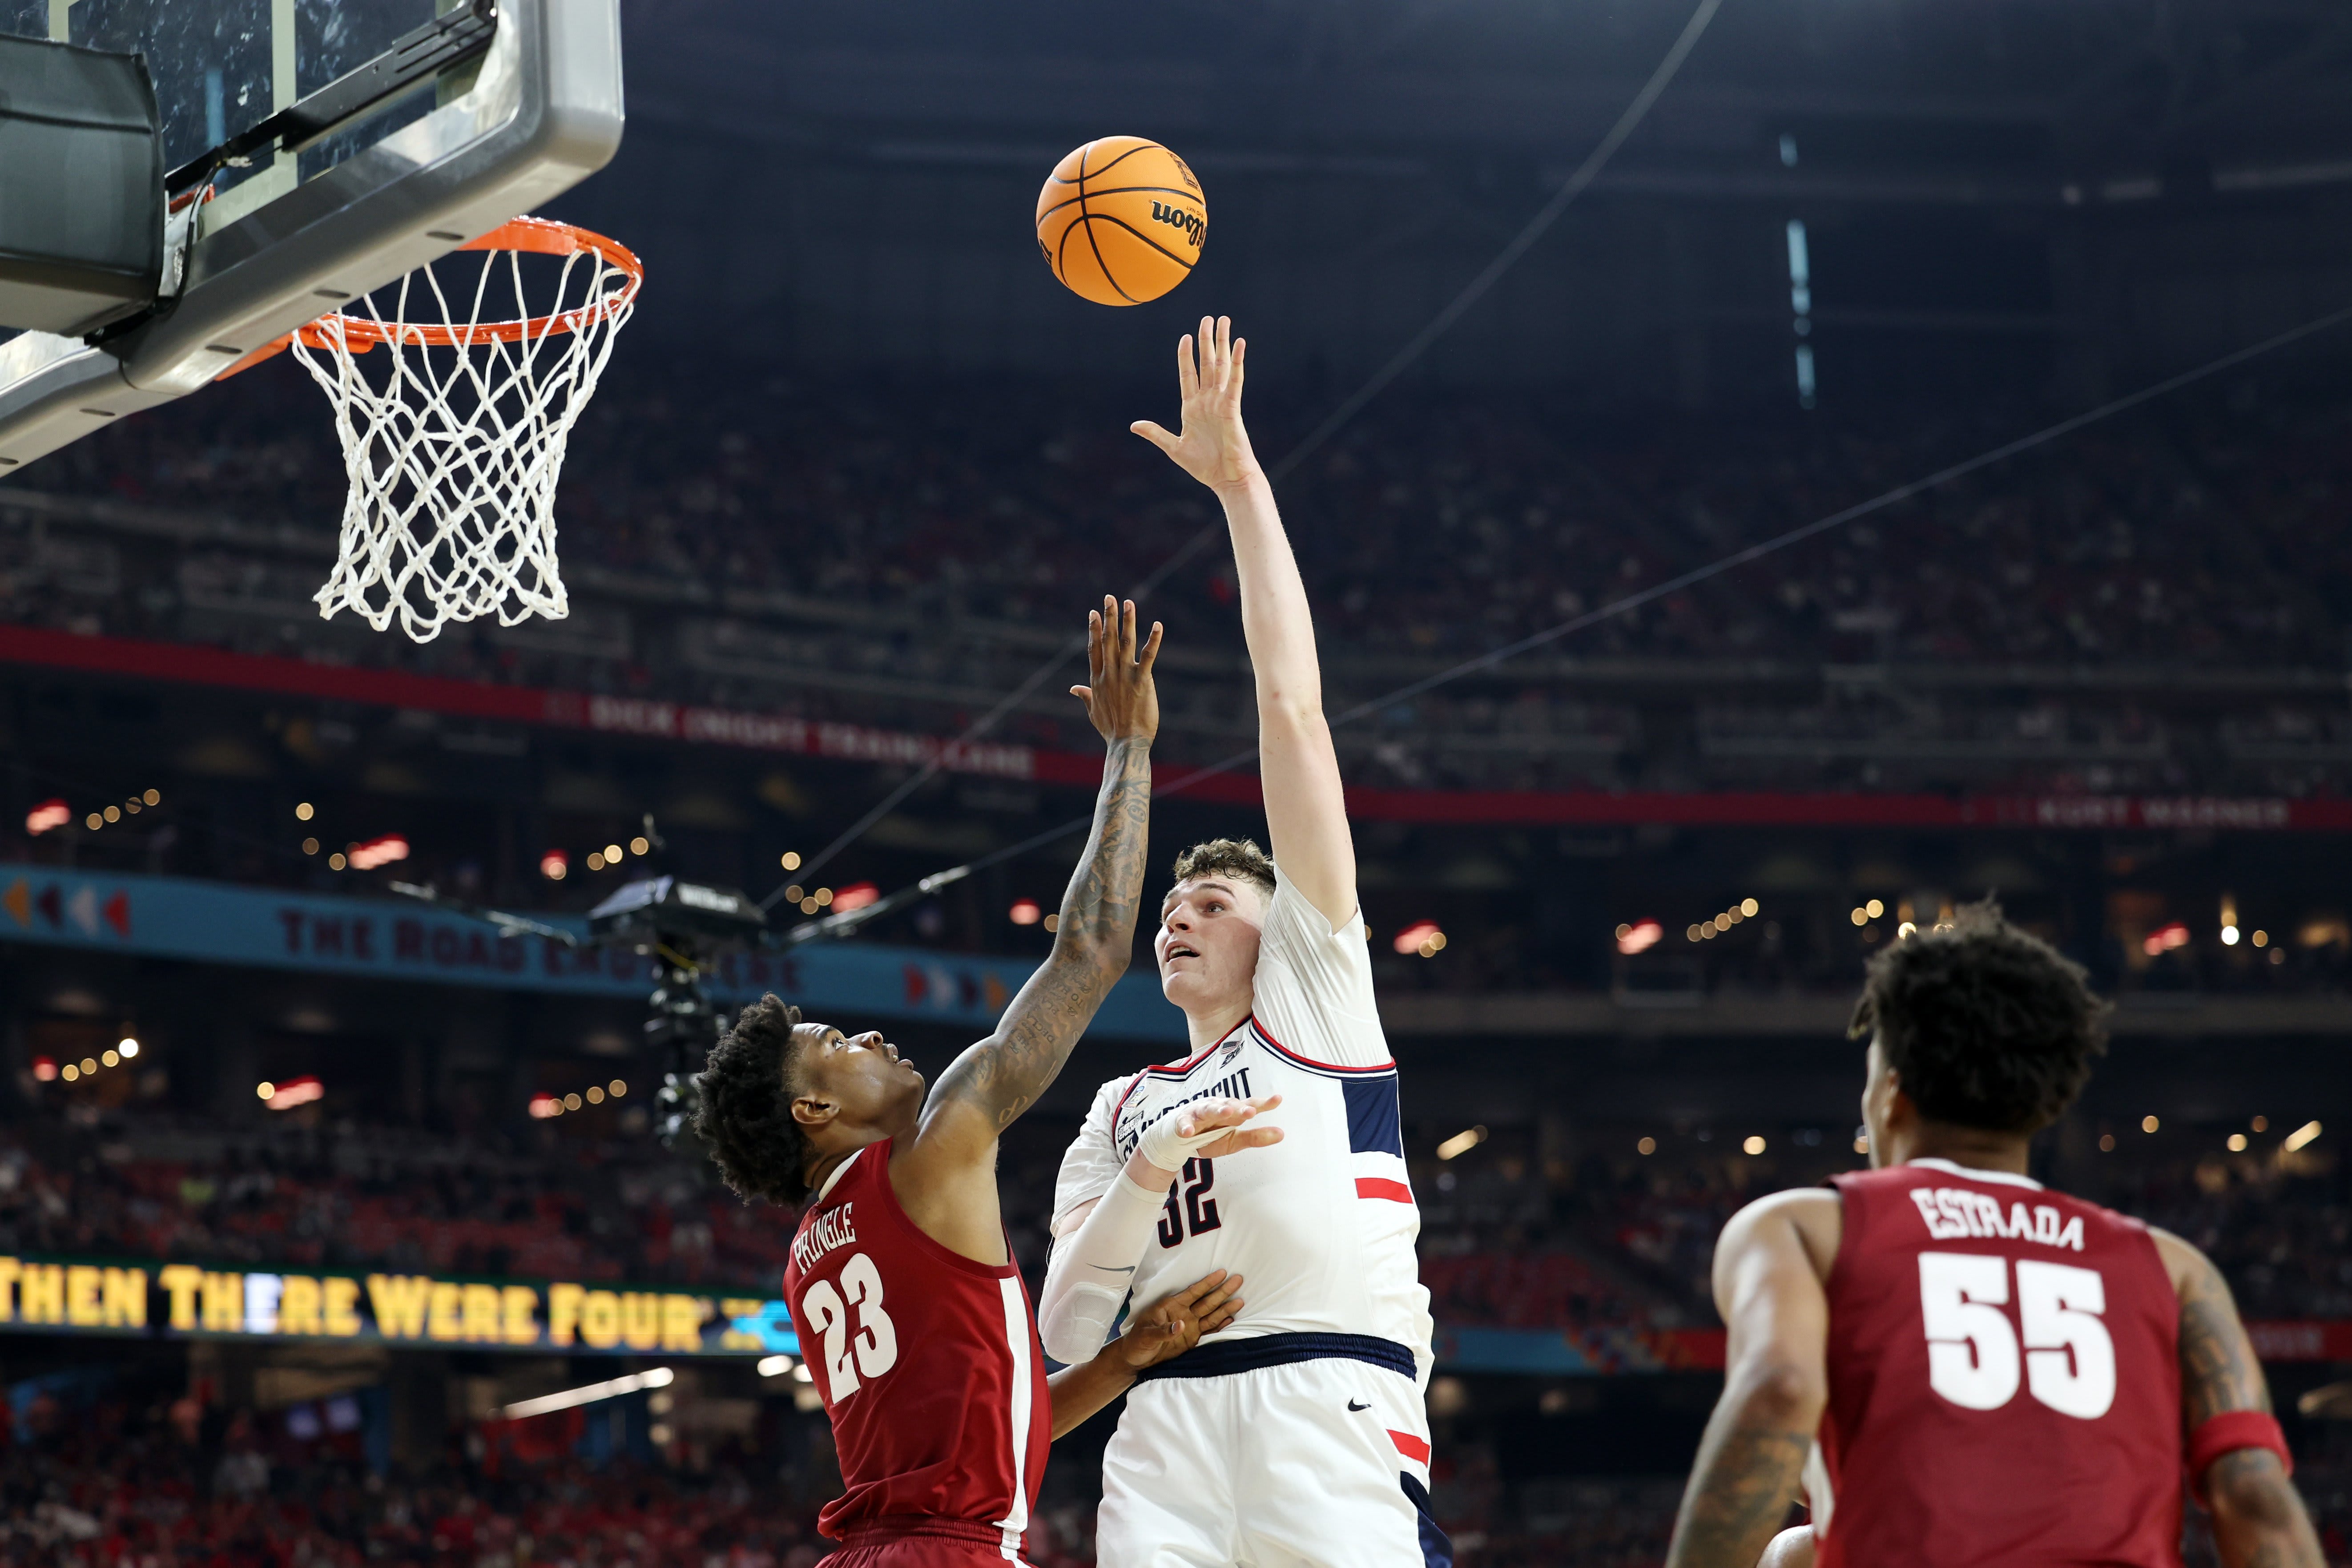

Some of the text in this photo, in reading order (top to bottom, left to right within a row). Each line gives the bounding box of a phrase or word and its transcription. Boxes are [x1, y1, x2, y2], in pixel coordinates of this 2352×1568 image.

[279, 909, 375, 962] THE
[393, 919, 528, 974] ROAD
[793, 1201, 857, 1276] PRINGLE
[1157, 1157, 1221, 1249] 32
[1910, 1187, 2085, 1252] ESTRADA
[0, 1255, 703, 1353] THEN THERE WERE FOUR
[801, 1252, 898, 1405] 23
[1917, 1251, 2117, 1420] 55
